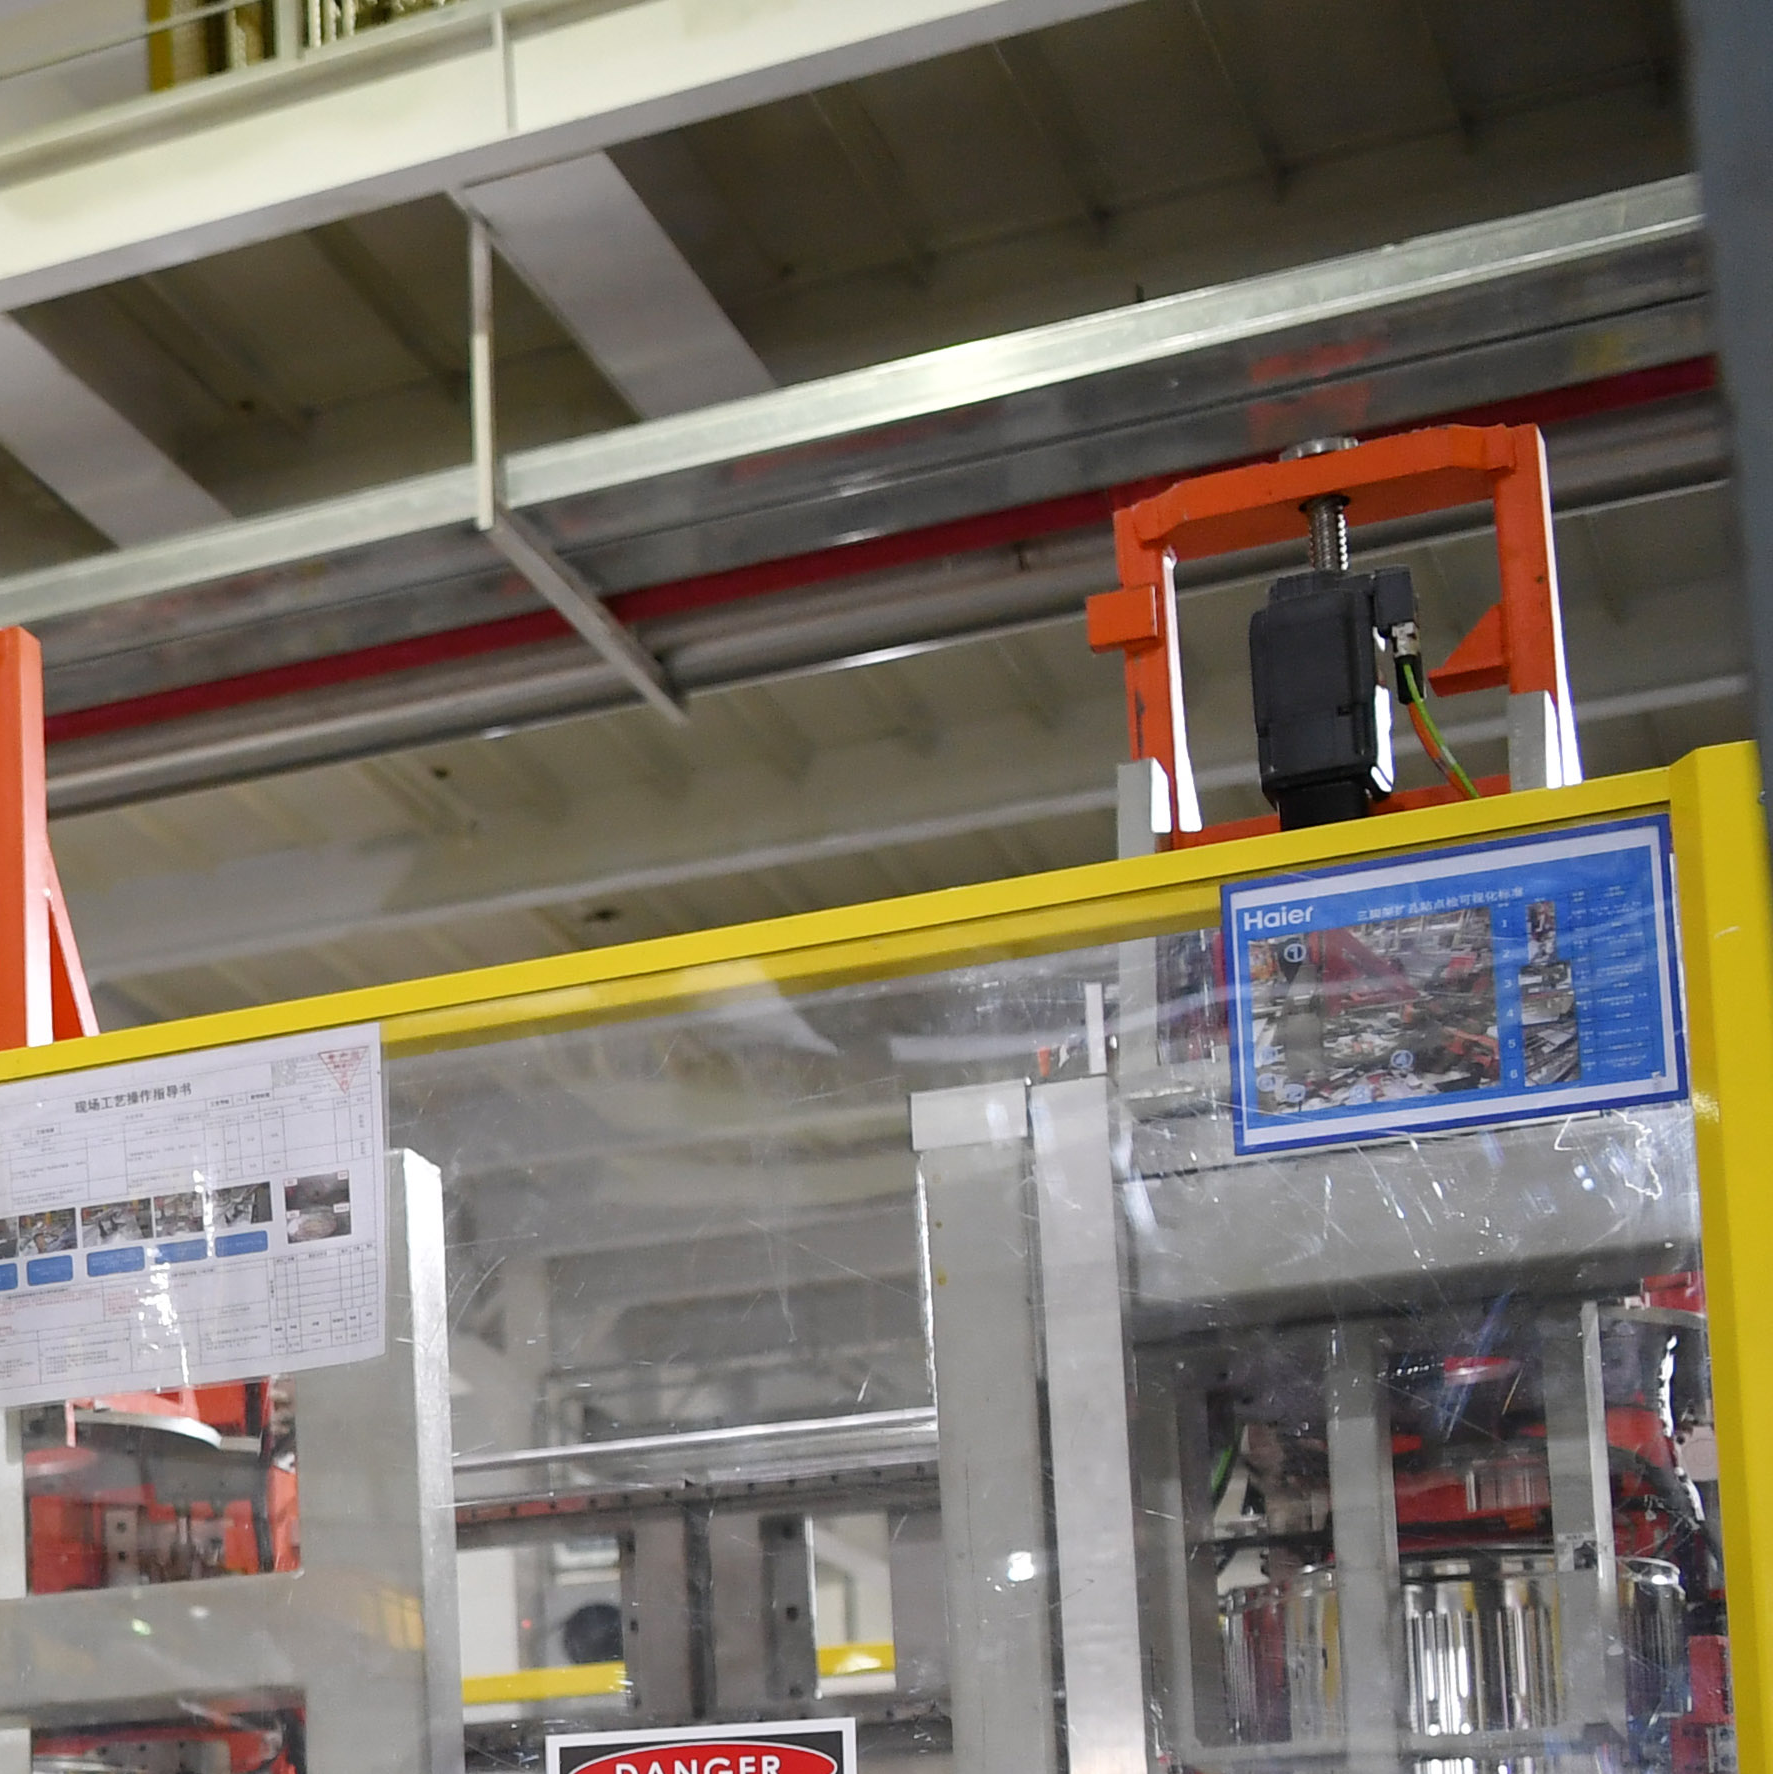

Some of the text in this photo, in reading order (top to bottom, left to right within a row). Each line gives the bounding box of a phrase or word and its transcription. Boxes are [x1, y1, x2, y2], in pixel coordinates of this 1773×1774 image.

[1243, 904, 1314, 932] Haier
[75, 1082, 192, 1114] 现场工艺操作指导书
